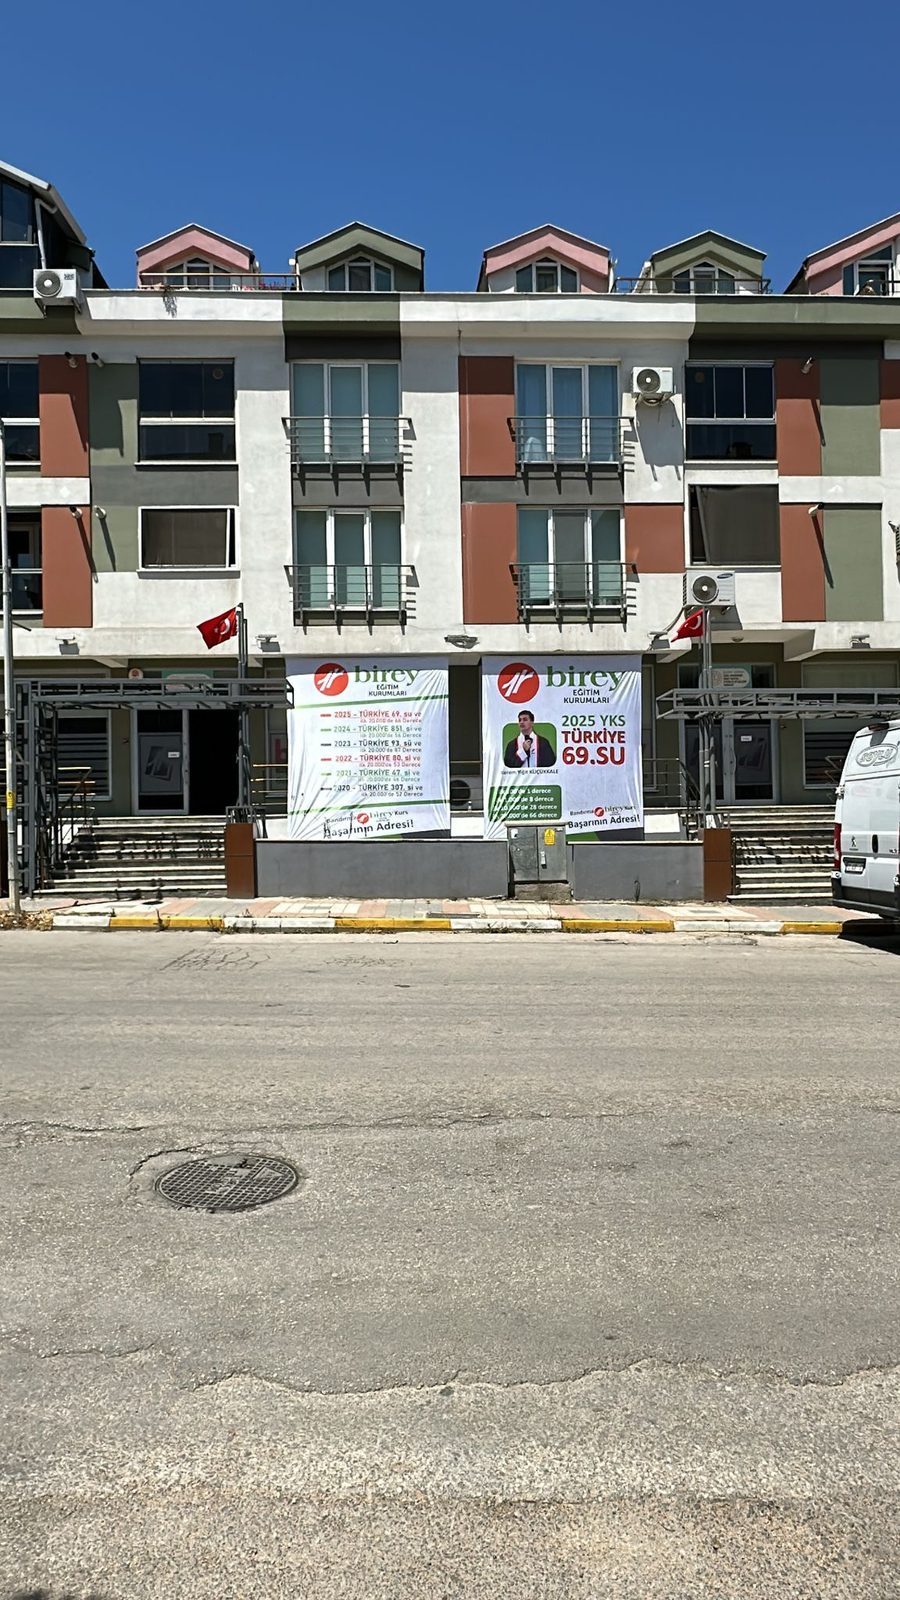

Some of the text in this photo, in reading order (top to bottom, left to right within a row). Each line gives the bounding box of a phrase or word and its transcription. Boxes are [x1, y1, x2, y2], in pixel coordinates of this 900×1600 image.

[354, 665, 420, 686] birey
[546, 665, 622, 691] birey
[359, 709, 390, 717] TÜRKİYE
[561, 714, 626, 727] 2025 YKS
[358, 724, 389, 732] TÜRKİYE
[561, 728, 626, 743] TÜRKİYE
[358, 739, 389, 747] TÜRKİYE
[359, 753, 390, 761] TÜRKİYE
[562, 746, 626, 765] 69.SU
[359, 768, 390, 776] TÜRKİYE
[358, 783, 389, 791] TÜRKİYE
[376, 819, 414, 831] Adresi!
[568, 814, 641, 829] Başarının Adresi!
